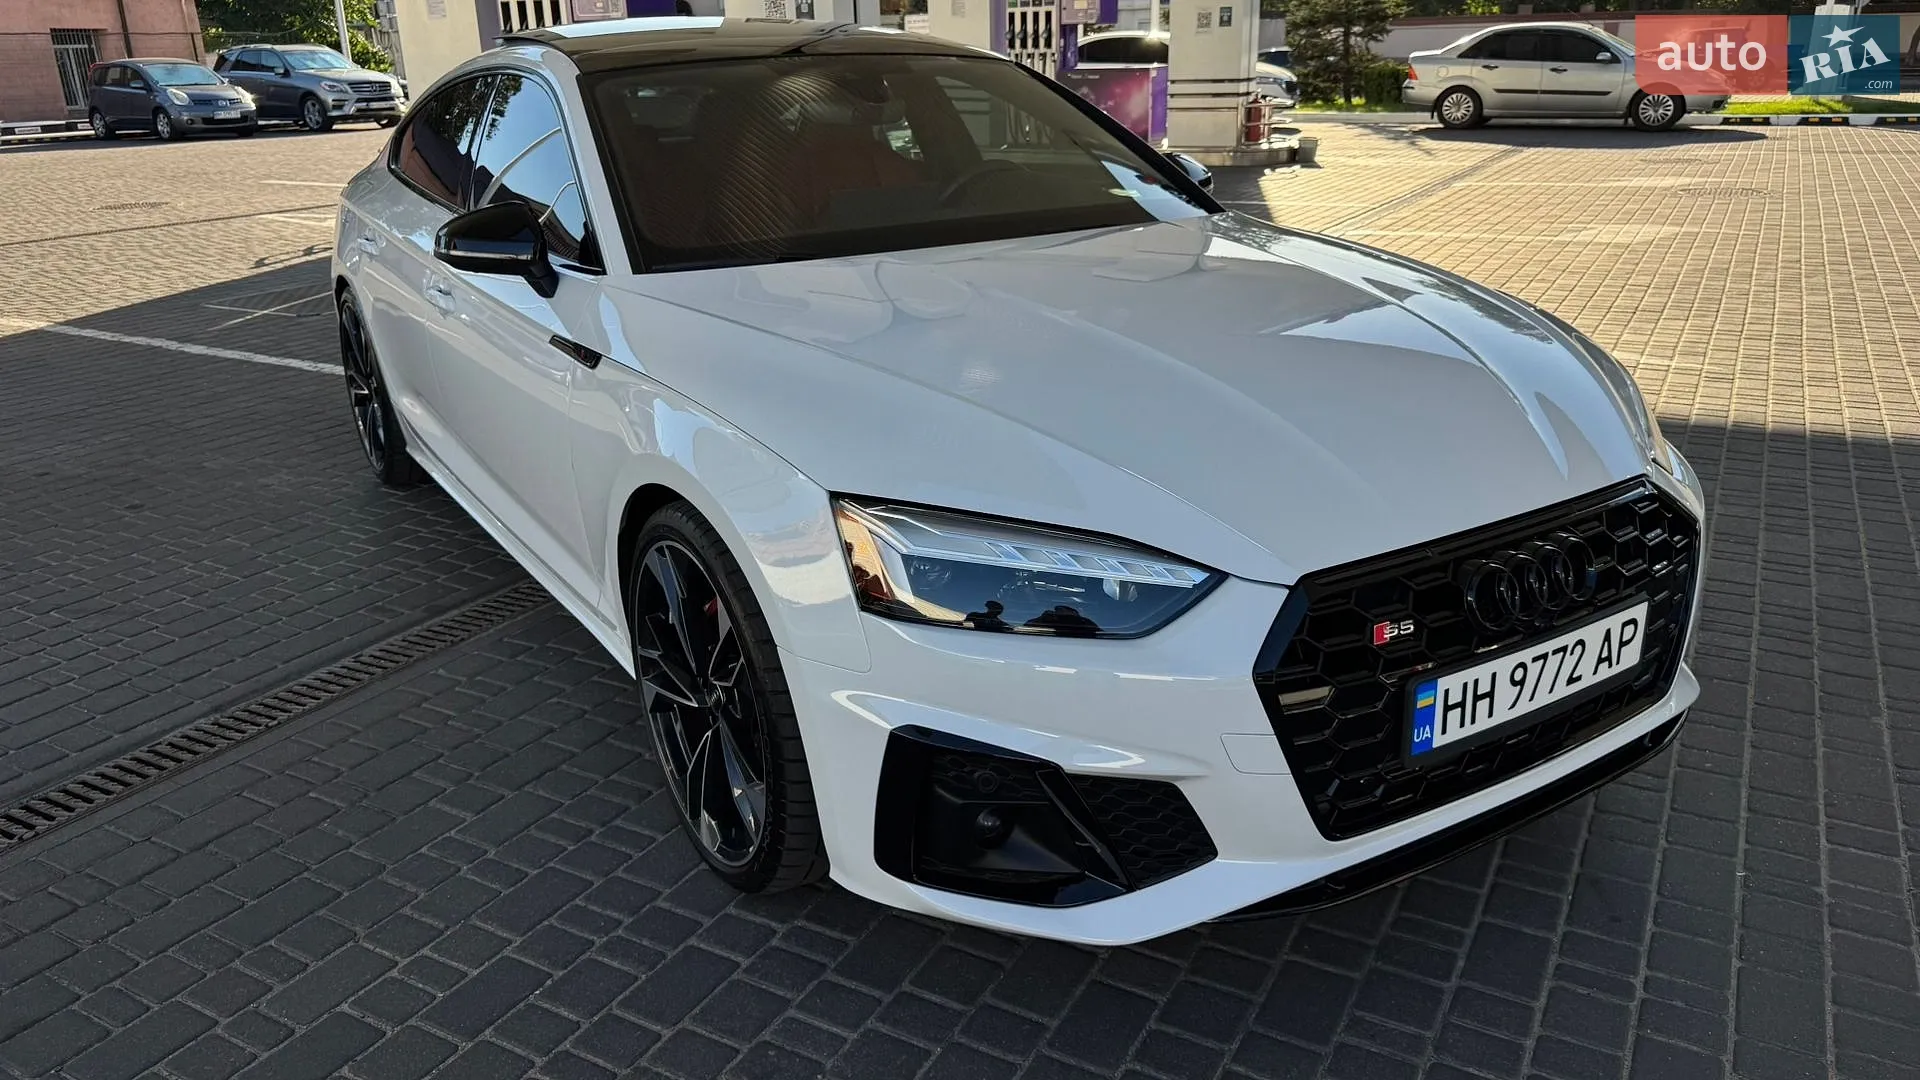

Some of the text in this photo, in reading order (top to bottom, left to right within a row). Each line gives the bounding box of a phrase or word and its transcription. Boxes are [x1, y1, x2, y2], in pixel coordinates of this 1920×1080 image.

[1383, 620, 1414, 638] S5
[1440, 617, 1639, 736] HH 9772 AP
[1413, 724, 1432, 743] UA
